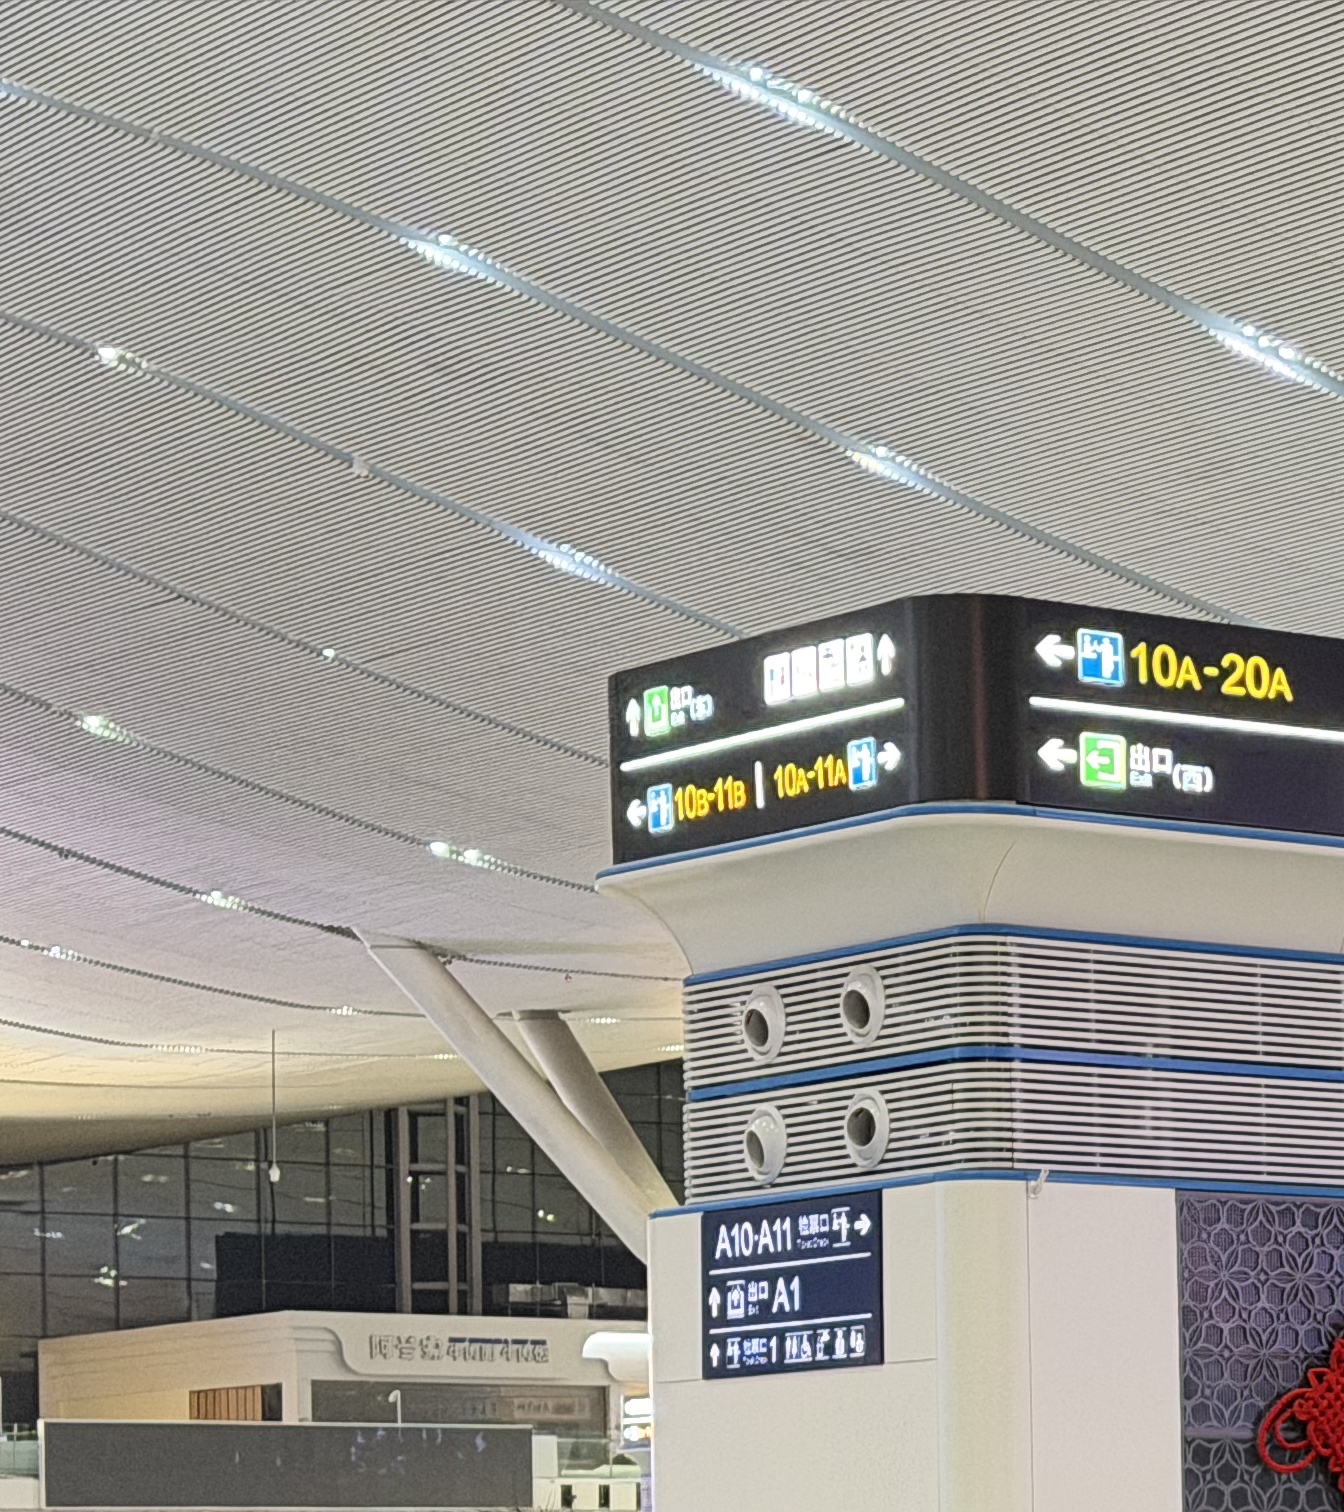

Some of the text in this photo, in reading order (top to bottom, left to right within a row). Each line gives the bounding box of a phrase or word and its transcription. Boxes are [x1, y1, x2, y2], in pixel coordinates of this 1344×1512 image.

[1131, 642, 1294, 702] 10A-20A
[774, 753, 847, 799] 10A-11A
[1130, 743, 1174, 774] 出口
[675, 775, 747, 821] 10B-11B
[747, 1275, 800, 1314] 出口 A1
